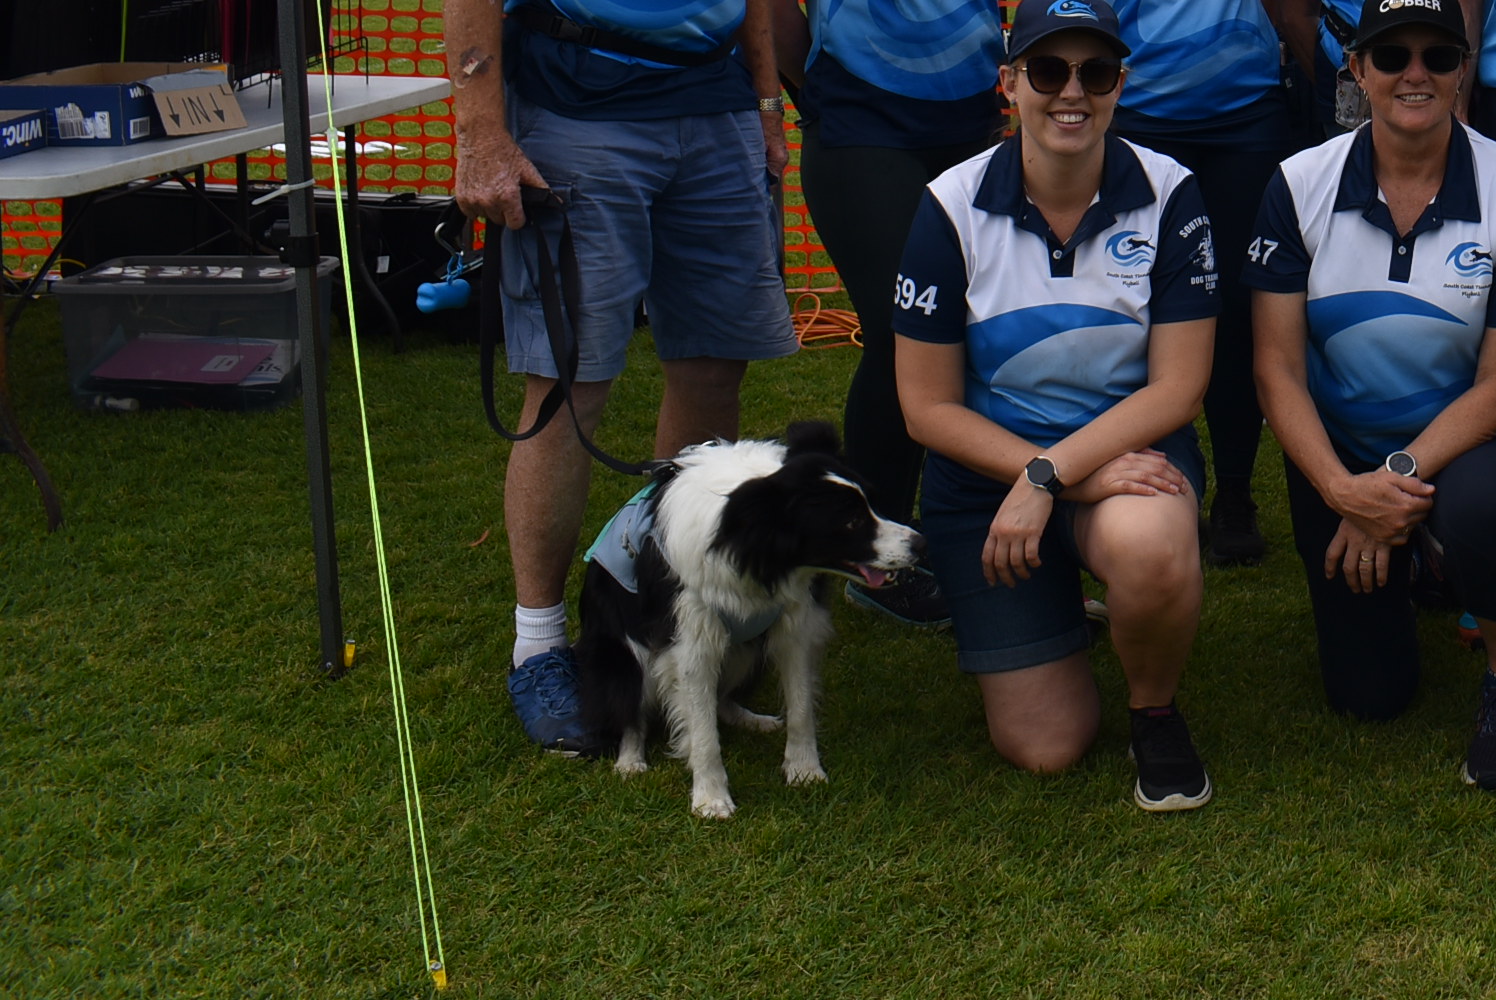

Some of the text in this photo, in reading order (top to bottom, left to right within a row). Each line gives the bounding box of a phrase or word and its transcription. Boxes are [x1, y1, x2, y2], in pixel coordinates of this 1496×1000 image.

[1179, 216, 1204, 239] SOUTH
[1247, 235, 1279, 266] 47
[1190, 275, 1205, 285] DOG
